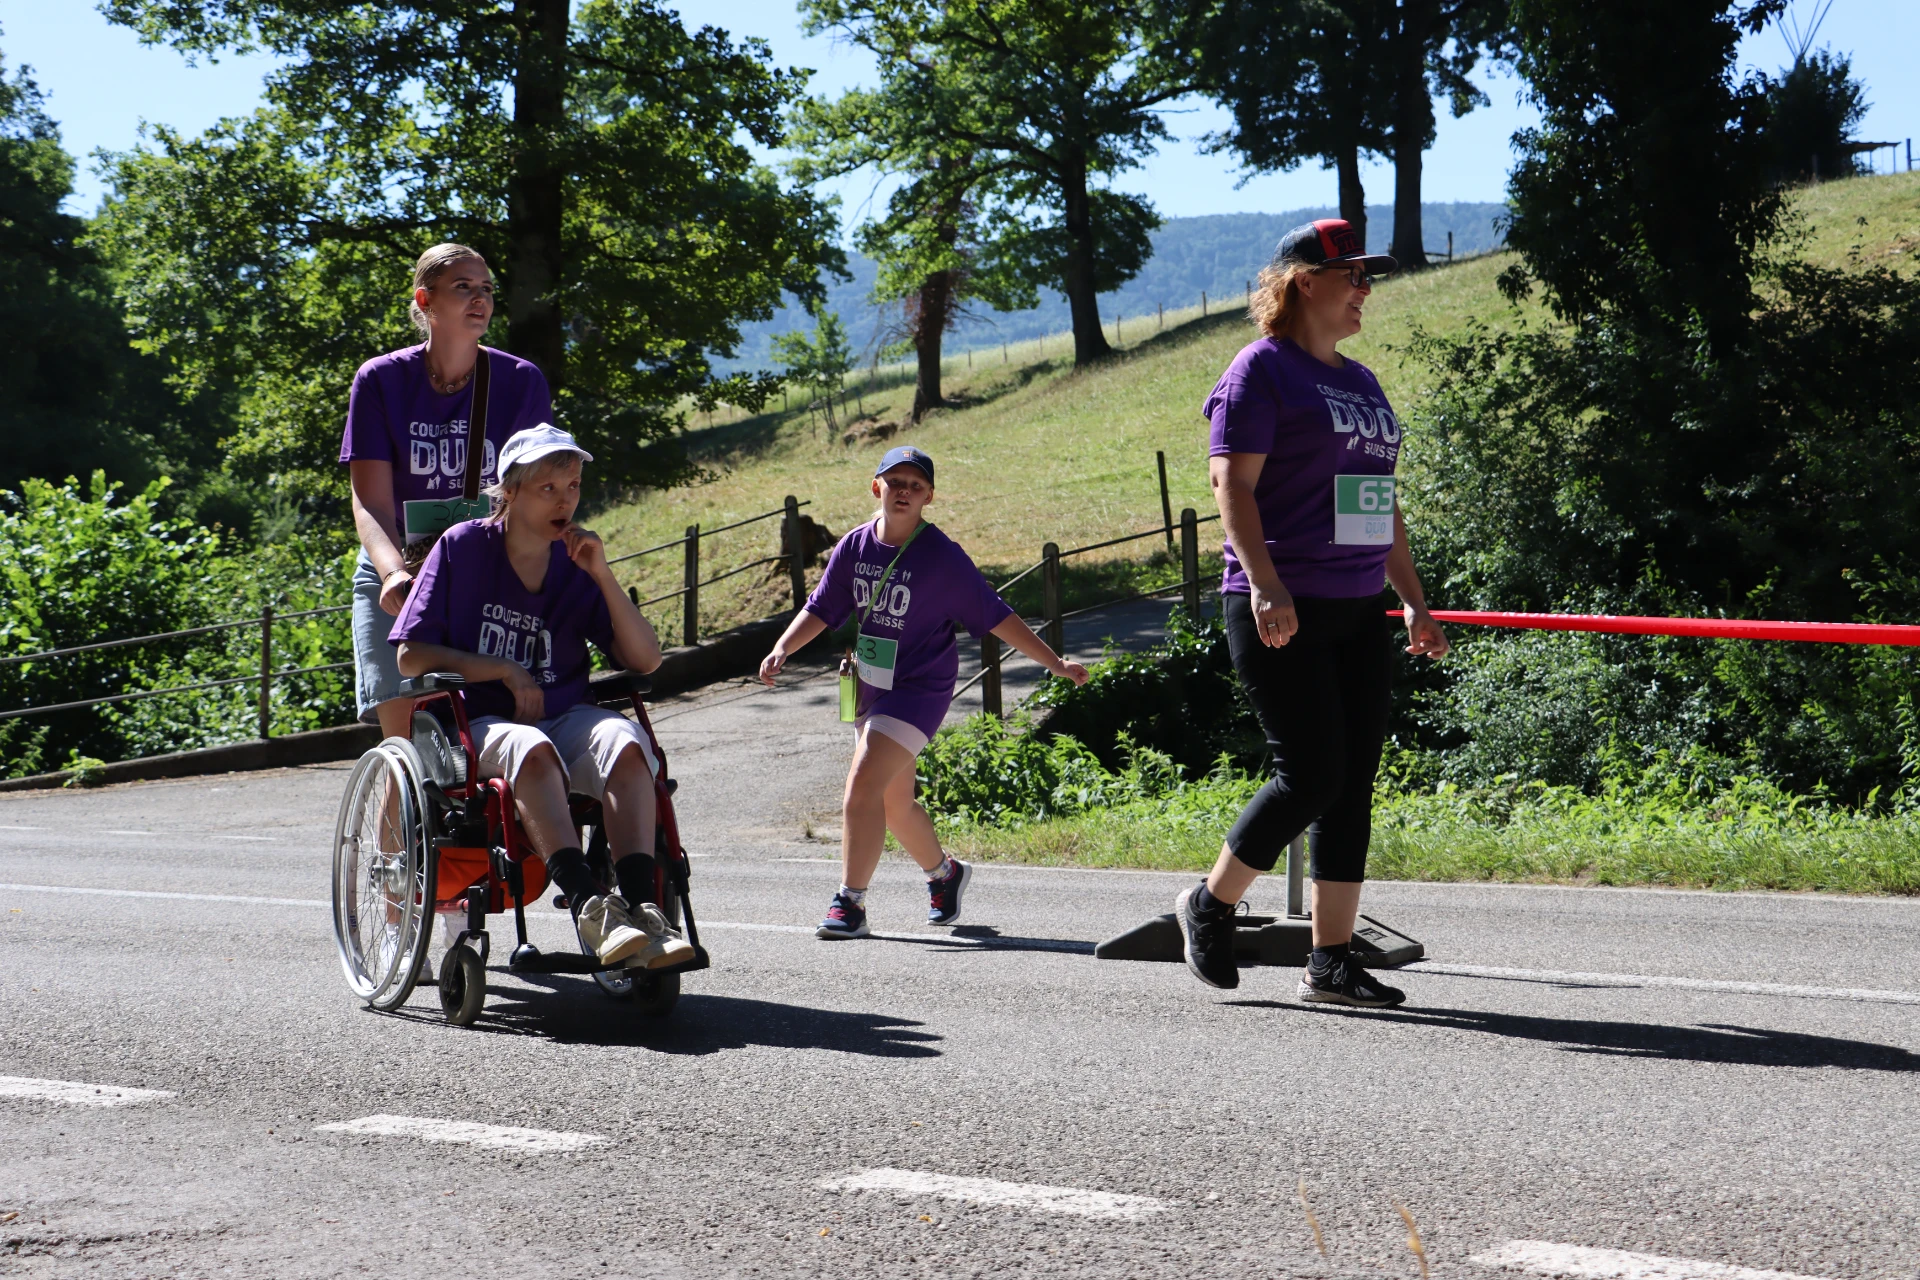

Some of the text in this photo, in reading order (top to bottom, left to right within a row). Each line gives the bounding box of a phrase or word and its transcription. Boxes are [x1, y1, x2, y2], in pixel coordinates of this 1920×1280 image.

[1316, 384, 1368, 404] COURSE
[409, 419, 468, 438] COURSE
[1326, 398, 1400, 444] DUO
[1364, 441, 1398, 461] SUISSE
[1358, 480, 1395, 512] 63
[1365, 521, 1386, 534] DUO
[482, 603, 540, 632] COURSE
[871, 613, 905, 631] SUISSE
[477, 621, 552, 669] DUO
